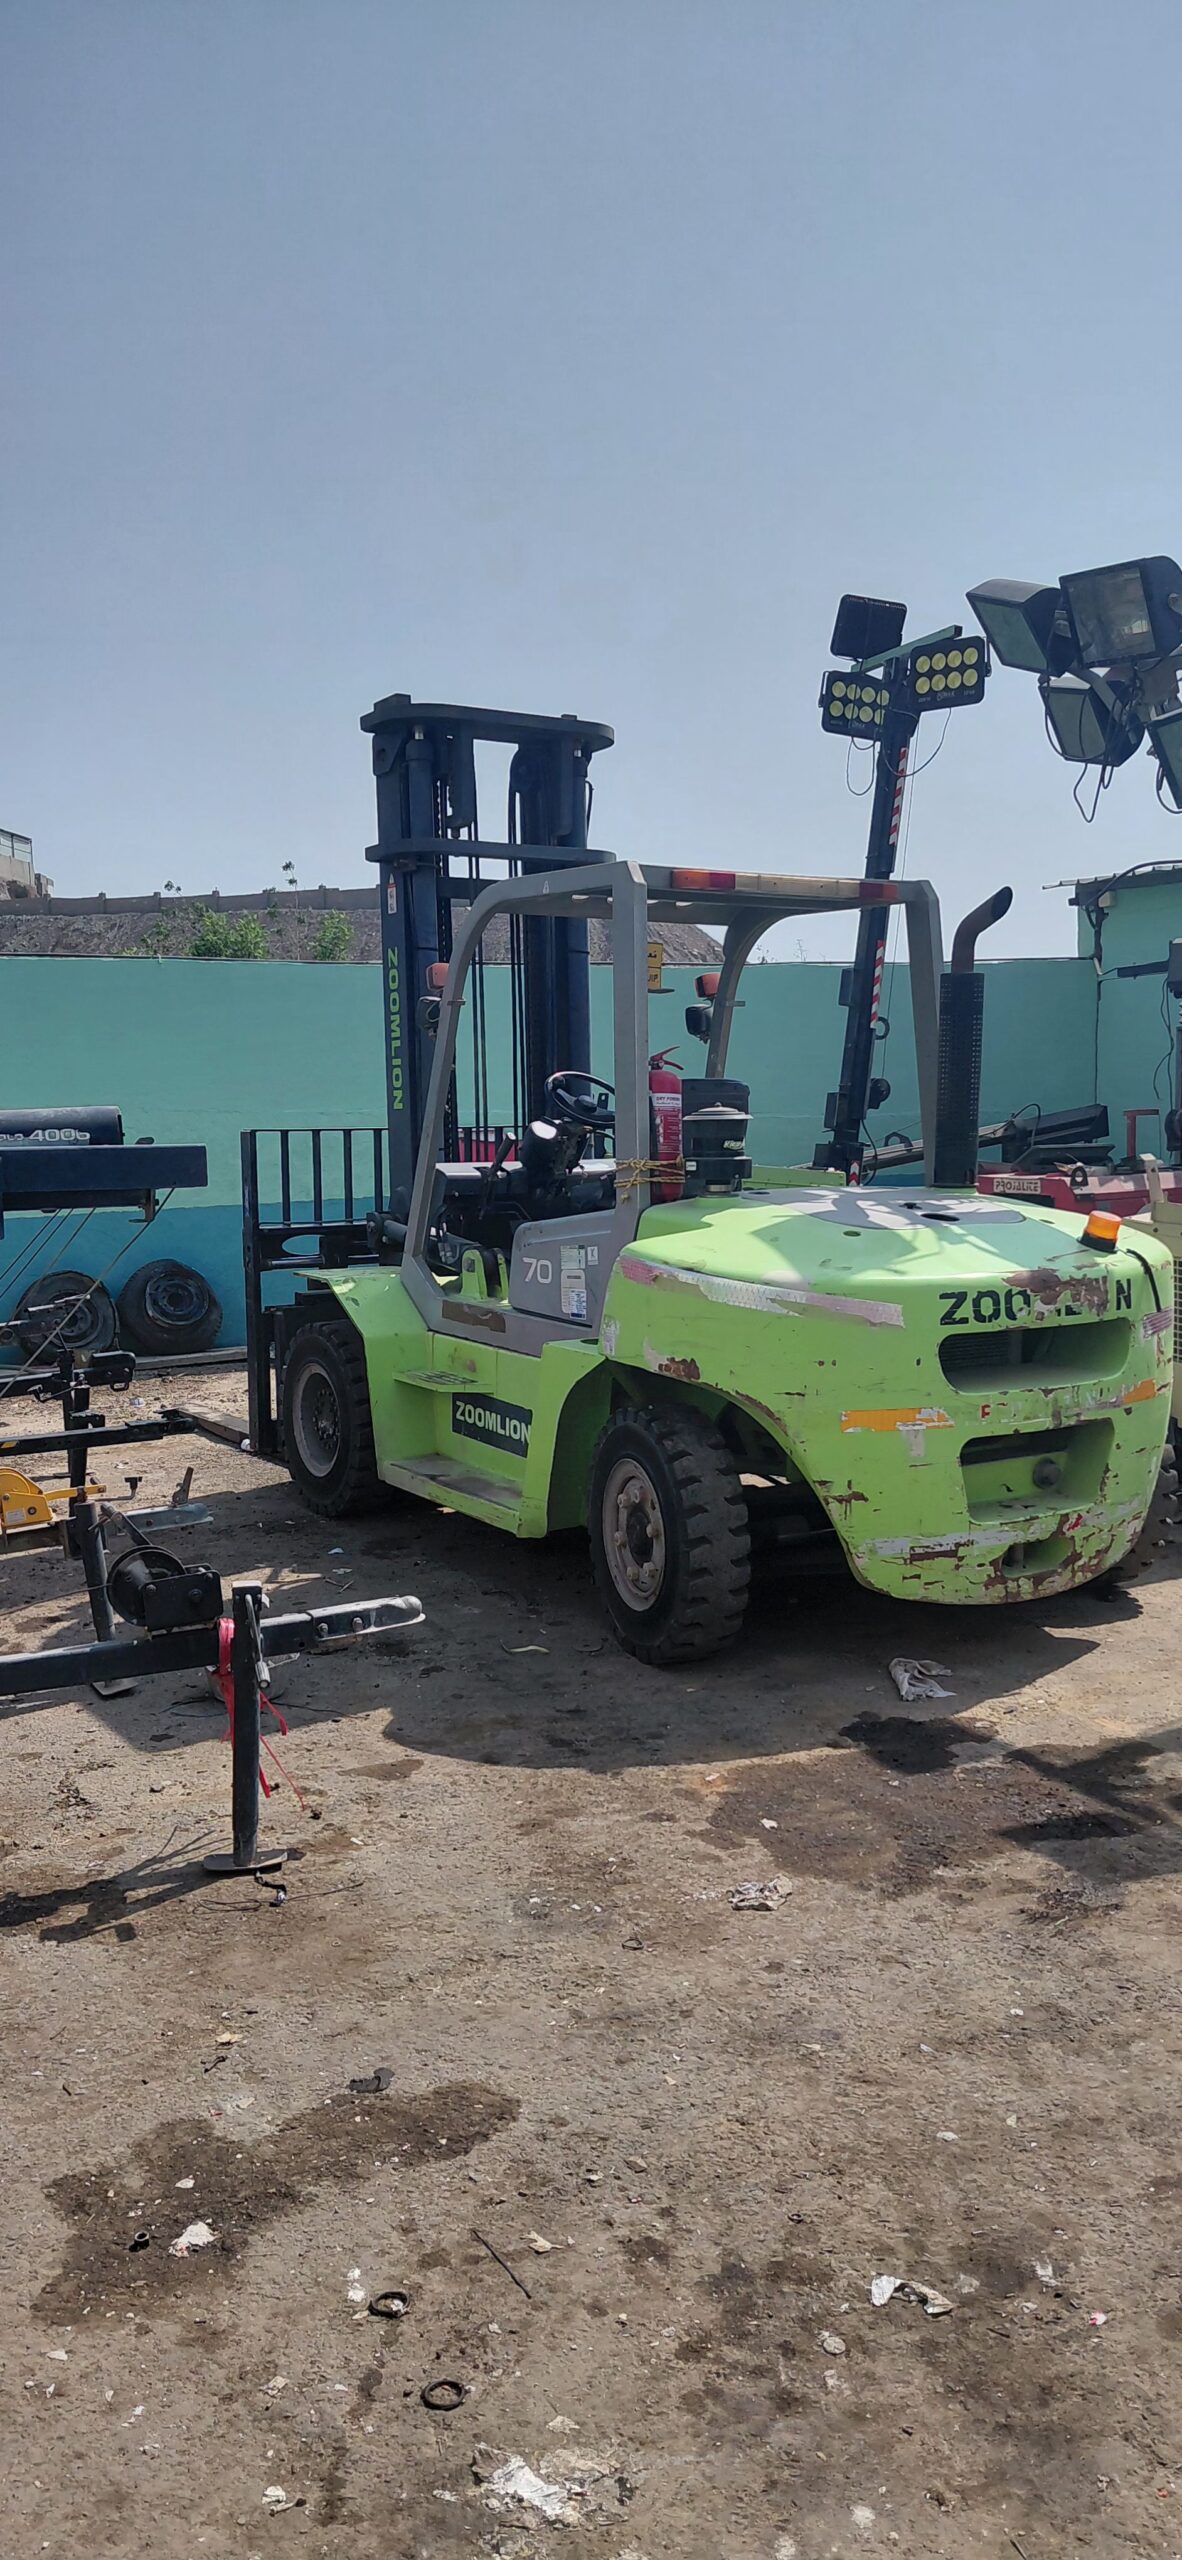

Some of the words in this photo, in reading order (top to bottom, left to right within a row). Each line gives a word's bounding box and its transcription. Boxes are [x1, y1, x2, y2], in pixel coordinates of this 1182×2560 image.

[387, 947, 403, 1109] ZOOMLION
[522, 1257, 552, 1284] 70
[939, 1279, 1131, 1325] ZOON
[455, 1400, 531, 1444] ZOOMLION
